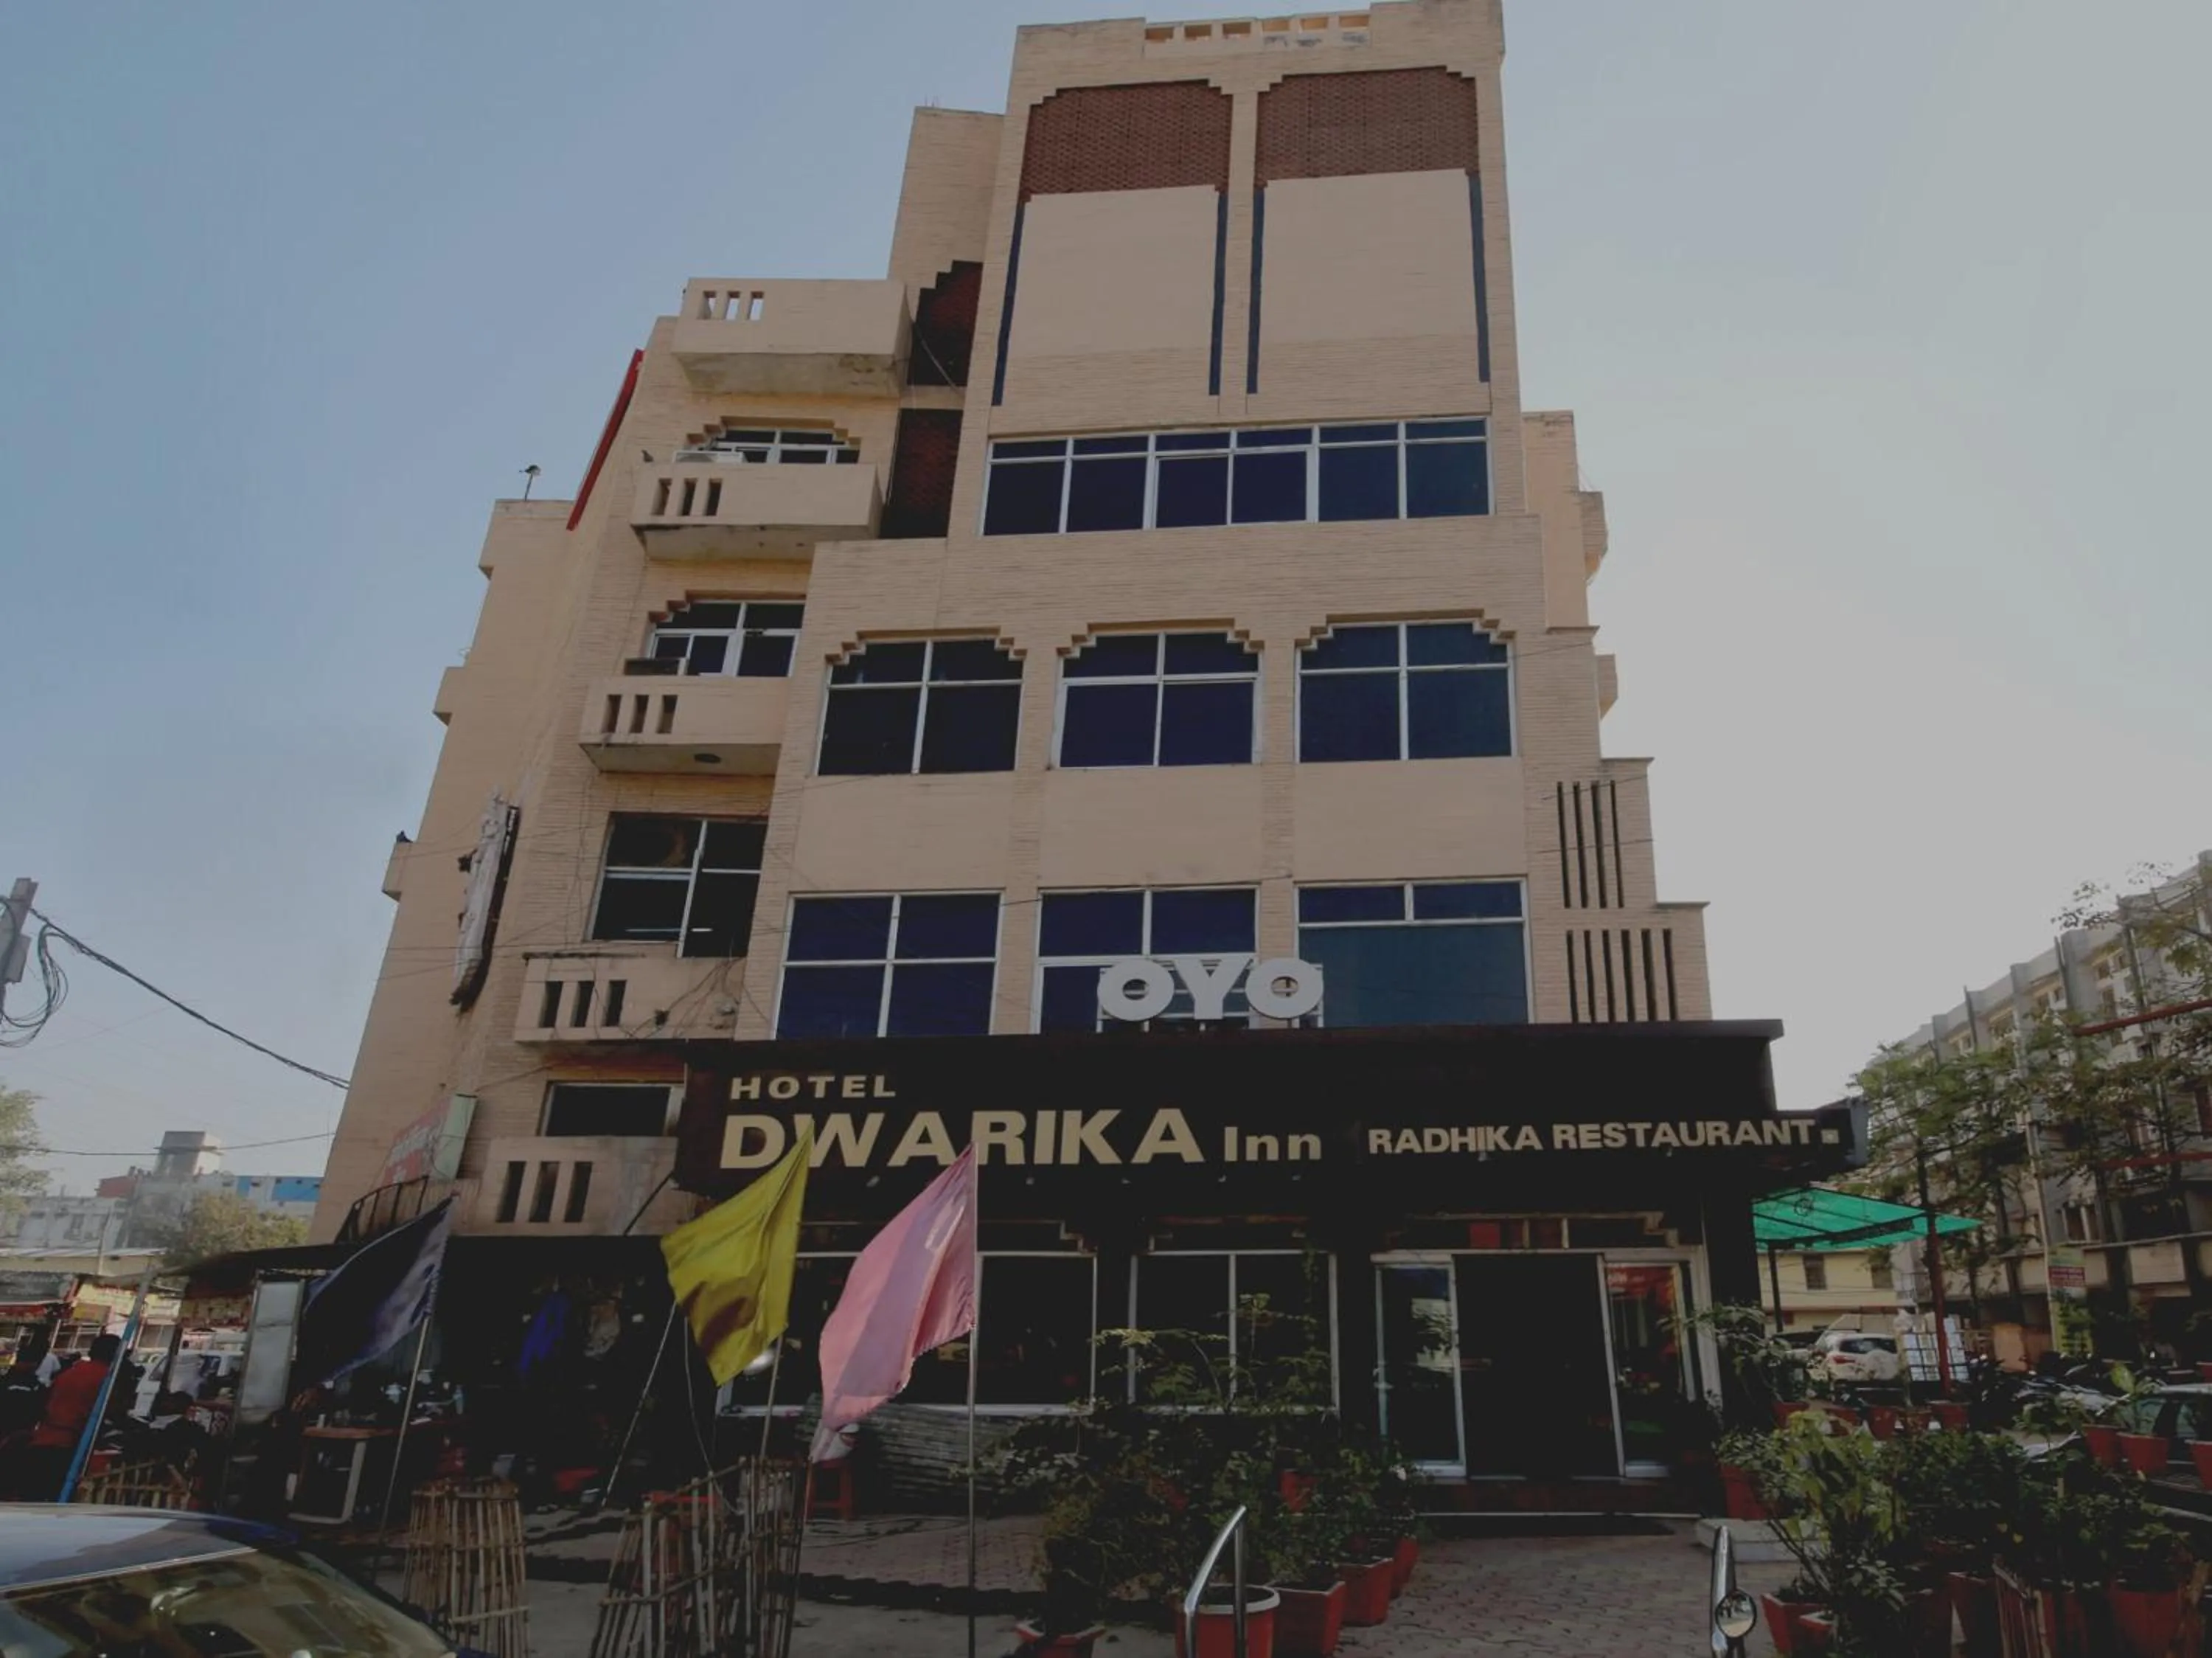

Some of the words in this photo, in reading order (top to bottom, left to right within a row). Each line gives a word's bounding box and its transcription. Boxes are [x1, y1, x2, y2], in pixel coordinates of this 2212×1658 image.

[1097, 958, 1324, 1021] OYO
[730, 1075, 896, 1100] HOTEL
[719, 1109, 1205, 1169] DWARIKA
[1224, 1126, 1322, 1163] Inn
[1368, 1125, 1543, 1155] RADHIKA
[1553, 1119, 1815, 1150] RESTAURANT
